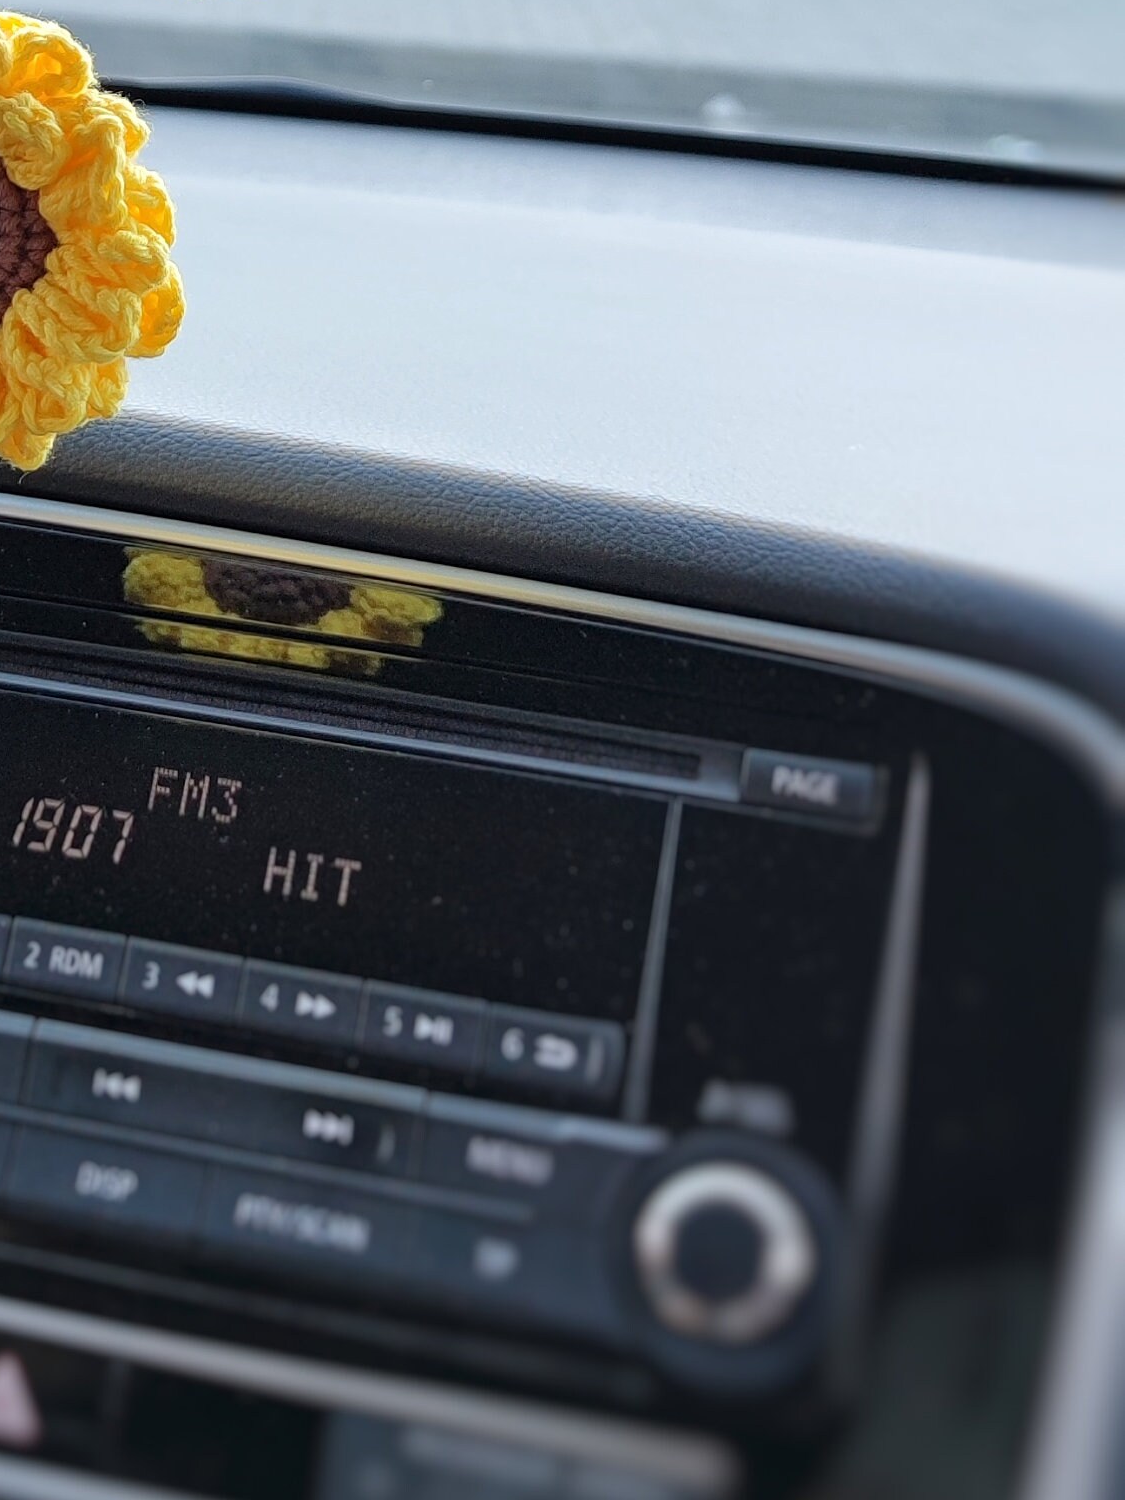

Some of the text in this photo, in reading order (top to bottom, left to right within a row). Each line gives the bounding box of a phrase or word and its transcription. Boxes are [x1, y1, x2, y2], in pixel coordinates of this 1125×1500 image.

[148, 766, 242, 823] FM3
[12, 798, 134, 863] 1907
[263, 847, 362, 906] HIT
[24, 942, 103, 980] 2 RDM
[142, 962, 160, 990] 3
[260, 984, 279, 1011] 4
[384, 1006, 403, 1037] 5
[501, 1029, 524, 1061] 6
[75, 1161, 138, 1200] DISP
